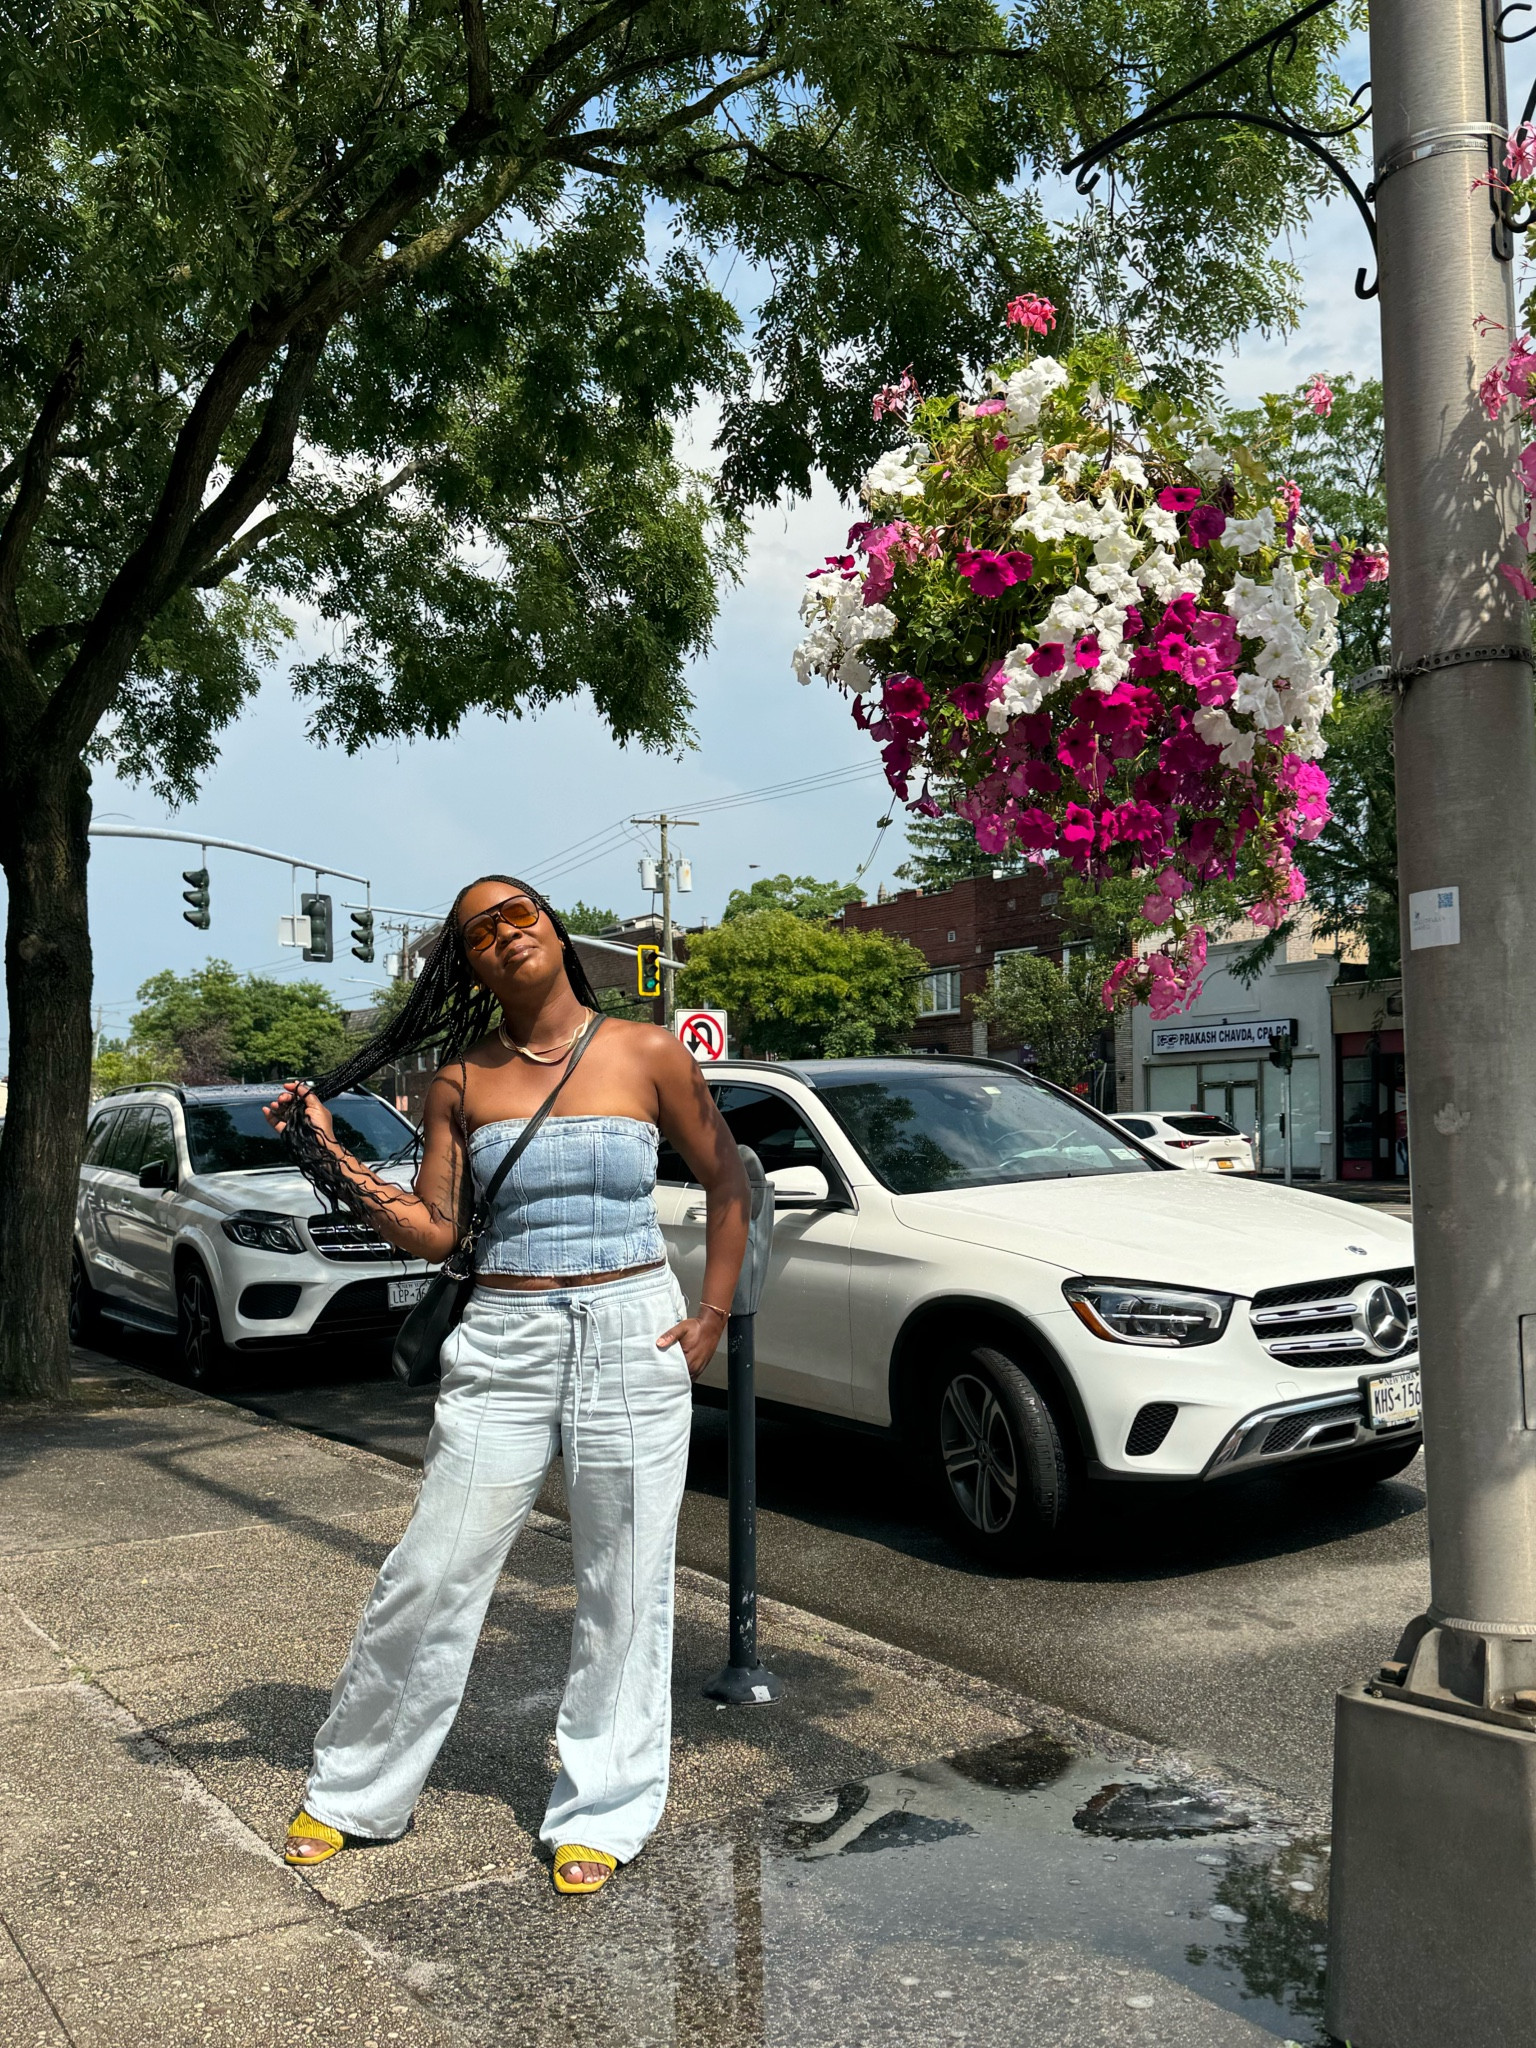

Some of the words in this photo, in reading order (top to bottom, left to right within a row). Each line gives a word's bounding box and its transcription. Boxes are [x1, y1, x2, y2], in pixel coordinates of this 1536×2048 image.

[1179, 1030, 1217, 1046] PRAKASH
[1218, 1028, 1255, 1043] CHAVDA,
[1257, 1026, 1273, 1040] CPA
[1385, 1375, 1399, 1385] NEW
[1400, 1372, 1416, 1382] YORK
